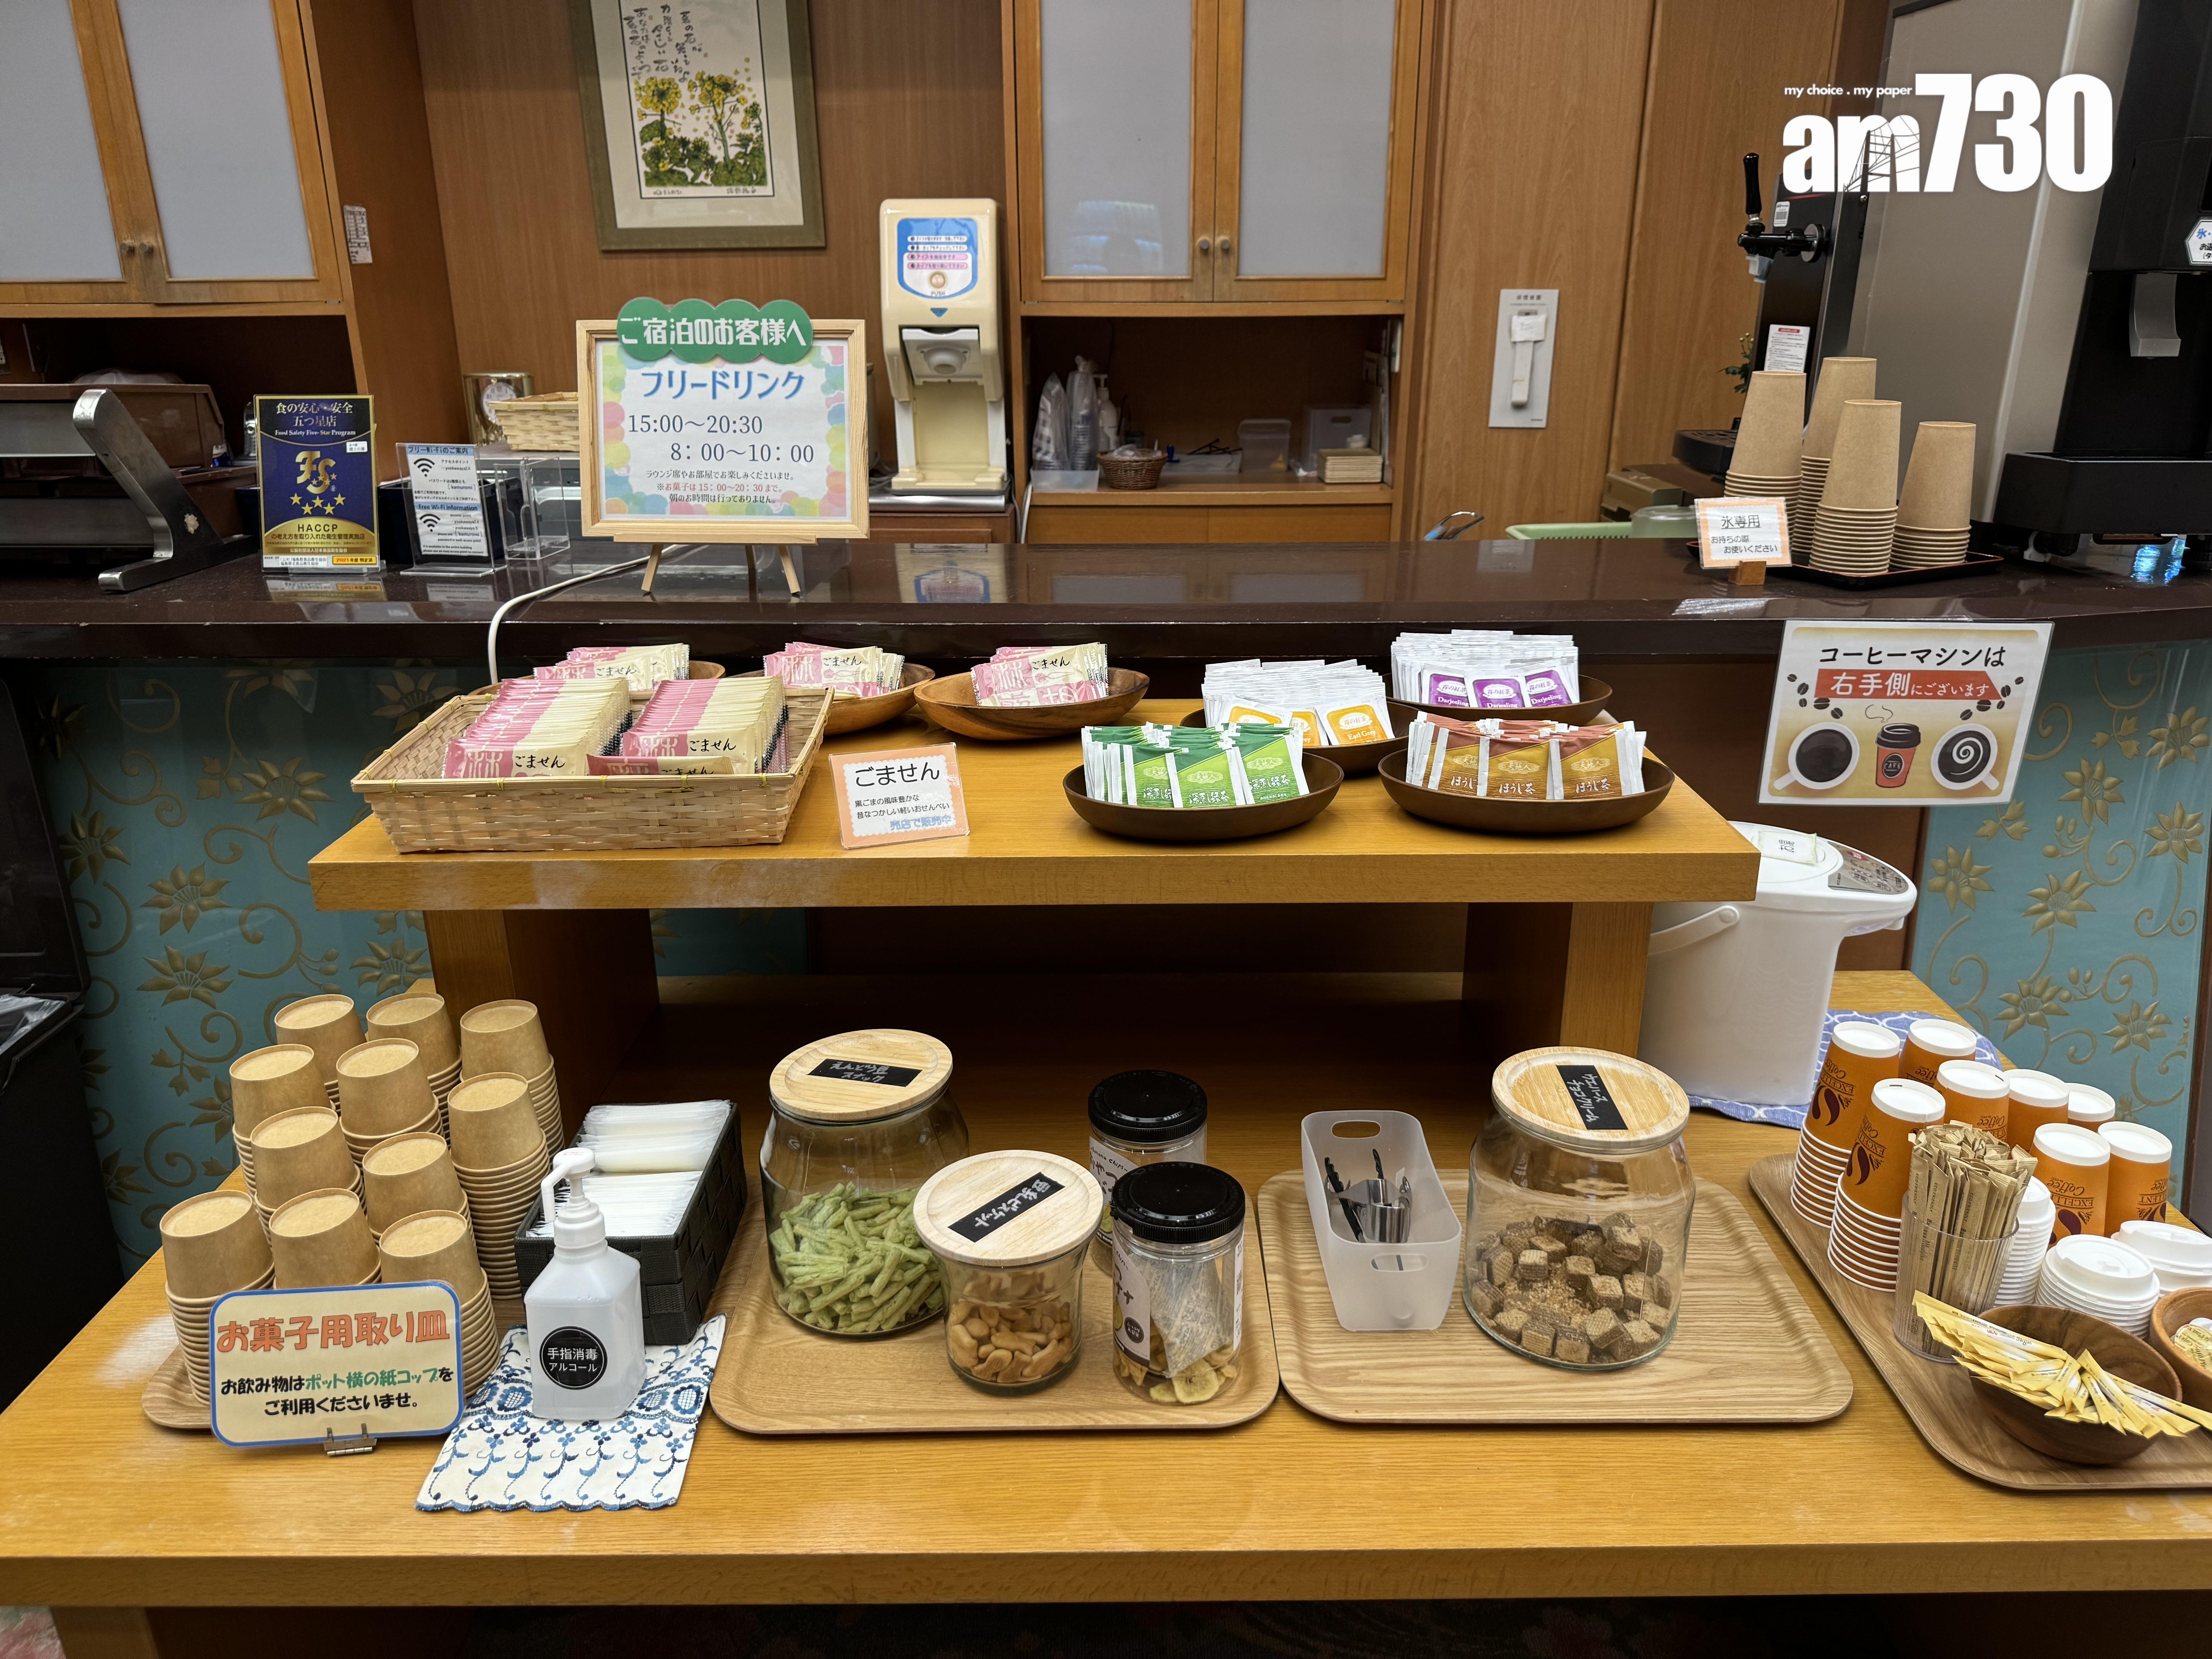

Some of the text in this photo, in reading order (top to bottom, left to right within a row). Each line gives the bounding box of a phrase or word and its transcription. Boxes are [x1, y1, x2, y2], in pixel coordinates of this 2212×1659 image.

[620, 316, 807, 346] ご宿泊のお客様へ
[641, 370, 805, 400] フリードリンク
[276, 402, 353, 414] 食の安心・安全
[293, 416, 337, 427] 五つ星店
[646, 470, 795, 480] ラウンジ席やお部屋でお楽しみくださいませ。
[669, 493, 776, 503] 朝のお時間は行っておりません。
[298, 524, 338, 532] HACCP
[1721, 515, 1760, 528] 氷専用
[1711, 535, 1750, 544] お持ちの際
[1723, 544, 1778, 554] お使いください
[823, 655, 862, 666] ごません
[1031, 656, 1070, 670] ごません
[1819, 646, 2006, 667] コーヒーマシンは
[596, 665, 637, 677] ごません
[1830, 672, 1990, 697] 右手側にございます
[1437, 696, 1469, 707] Darjeeling
[1531, 694, 1563, 704] Darjeeling
[1347, 732, 1361, 740] Earl
[689, 738, 737, 752] ごません
[515, 755, 566, 769] ごません
[855, 762, 939, 787] ごません
[1451, 776, 1478, 789] ほうじ
[1499, 782, 1536, 795] ほうじ茶
[1575, 778, 1611, 794] ほうじ茶
[1143, 787, 1172, 799] 深蒸し緑
[855, 794, 920, 808] 黒ごまの風味豊かな
[857, 803, 950, 819] 昔なつかしい軽いおせんべい
[890, 814, 952, 831] 売店で販売中
[830, 1061, 890, 1074] えんどう豆
[841, 1072, 885, 1083] スナック
[1567, 1079, 1599, 1122] チョコクリーム
[2047, 1180, 2085, 1196] Coffee
[974, 1179, 1051, 1227] 豆乳ビスケット
[216, 1310, 450, 1352] お菓子用取り皿
[547, 1347, 598, 1360] 手指消毒
[548, 1363, 598, 1372] アルコール
[220, 1367, 453, 1396] お飲み物はポット横の紙コップを
[264, 1392, 418, 1416] ご利用くださいませ。
